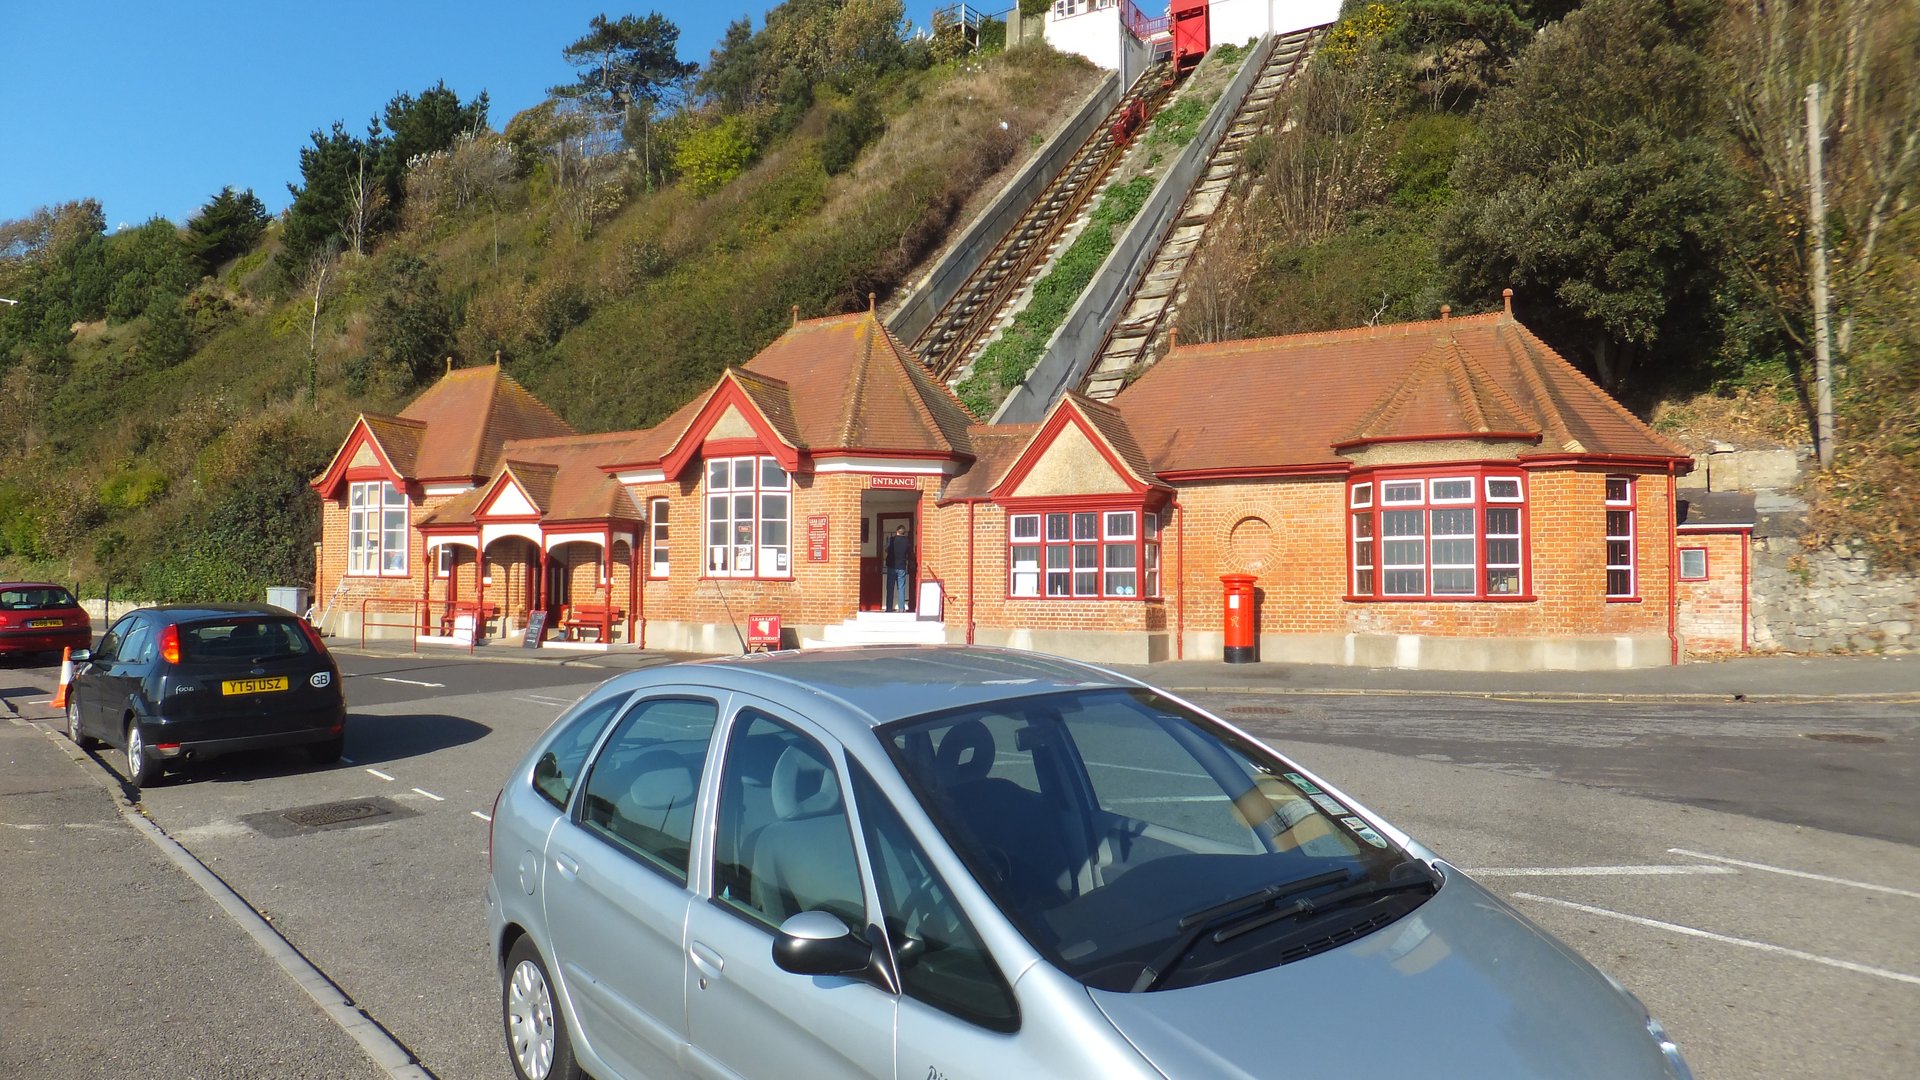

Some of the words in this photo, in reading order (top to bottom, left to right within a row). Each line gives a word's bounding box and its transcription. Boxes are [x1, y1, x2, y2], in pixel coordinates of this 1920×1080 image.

[873, 477, 914, 486] ENTRANCE
[312, 675, 328, 685] GB
[229, 680, 256, 693] YT51
[259, 679, 281, 690] USZ
